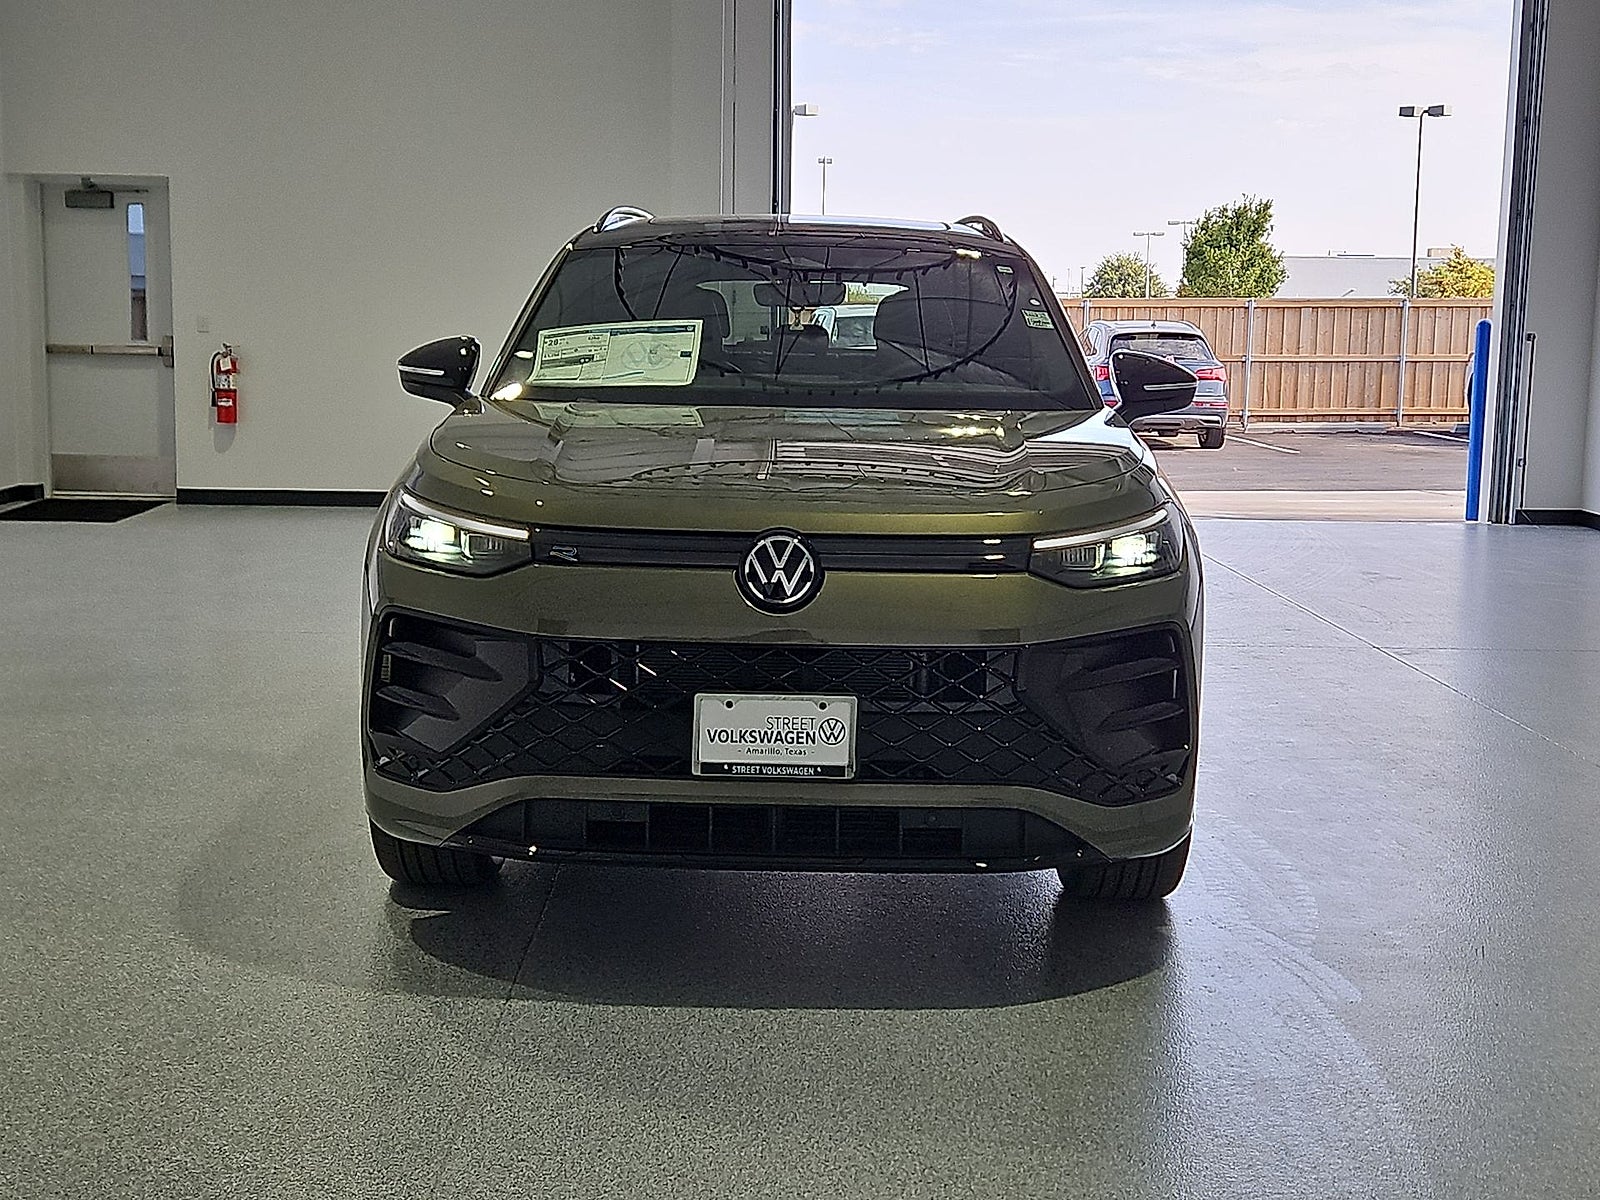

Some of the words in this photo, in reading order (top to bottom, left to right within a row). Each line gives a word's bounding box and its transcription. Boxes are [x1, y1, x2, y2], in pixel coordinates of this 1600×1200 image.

[766, 716, 817, 731] STREET
[706, 728, 817, 746] VOLKSWAGEN
[745, 747, 783, 756] Amarillo,
[785, 747, 807, 756] Texas
[732, 765, 761, 774] STREET
[761, 765, 815, 776] VOLKSWAGEN
